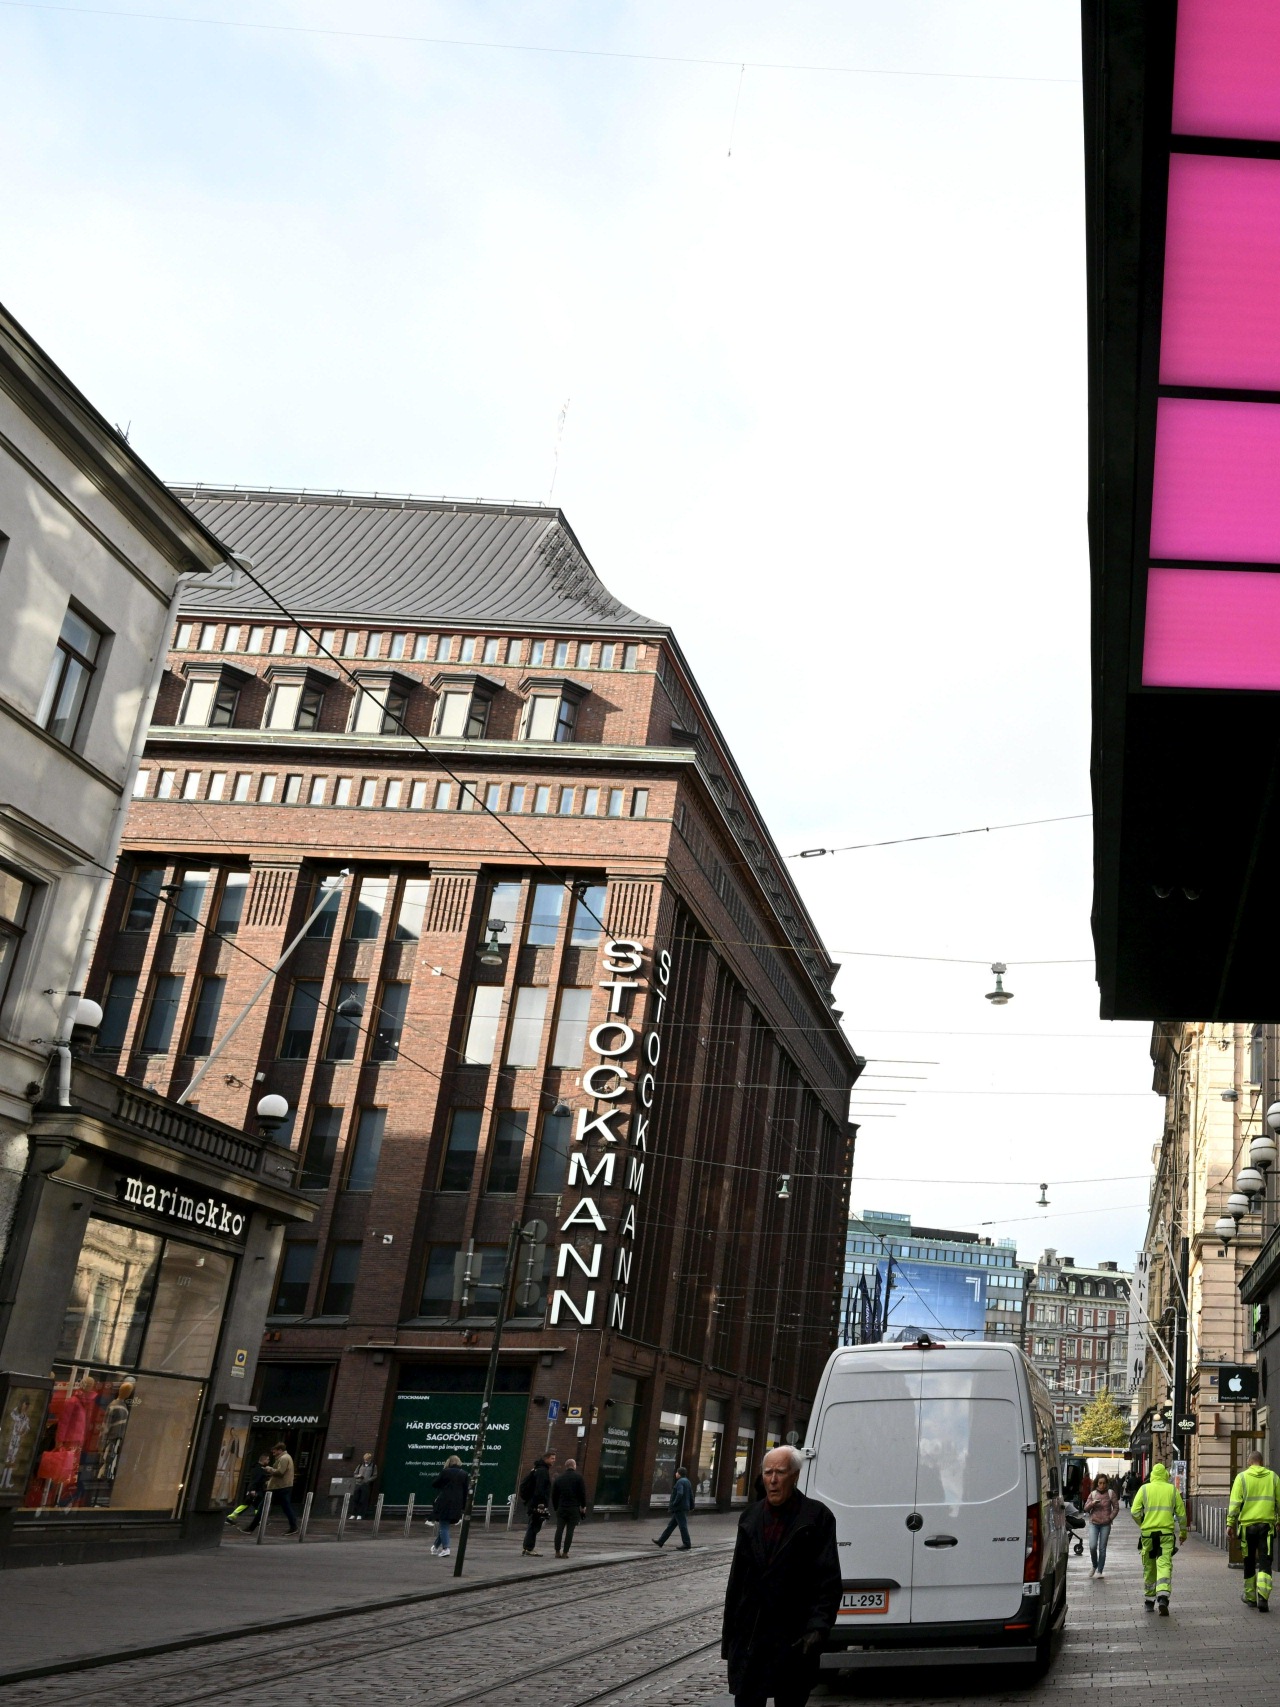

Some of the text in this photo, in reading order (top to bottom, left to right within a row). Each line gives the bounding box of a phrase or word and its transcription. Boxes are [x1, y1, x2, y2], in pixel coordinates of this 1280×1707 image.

[550, 939, 644, 1326] STOCKMANN
[611, 949, 671, 1331] STOCKMANN
[124, 1177, 244, 1236] marimekko
[252, 1415, 319, 1423] STOCKMANN
[406, 1420, 424, 1429] HÄR
[425, 1422, 451, 1430] BYGGS
[426, 1432, 486, 1441] SAGOFÖNST
[439, 1443, 446, 1451] på
[843, 1594, 883, 1607] LL-293
